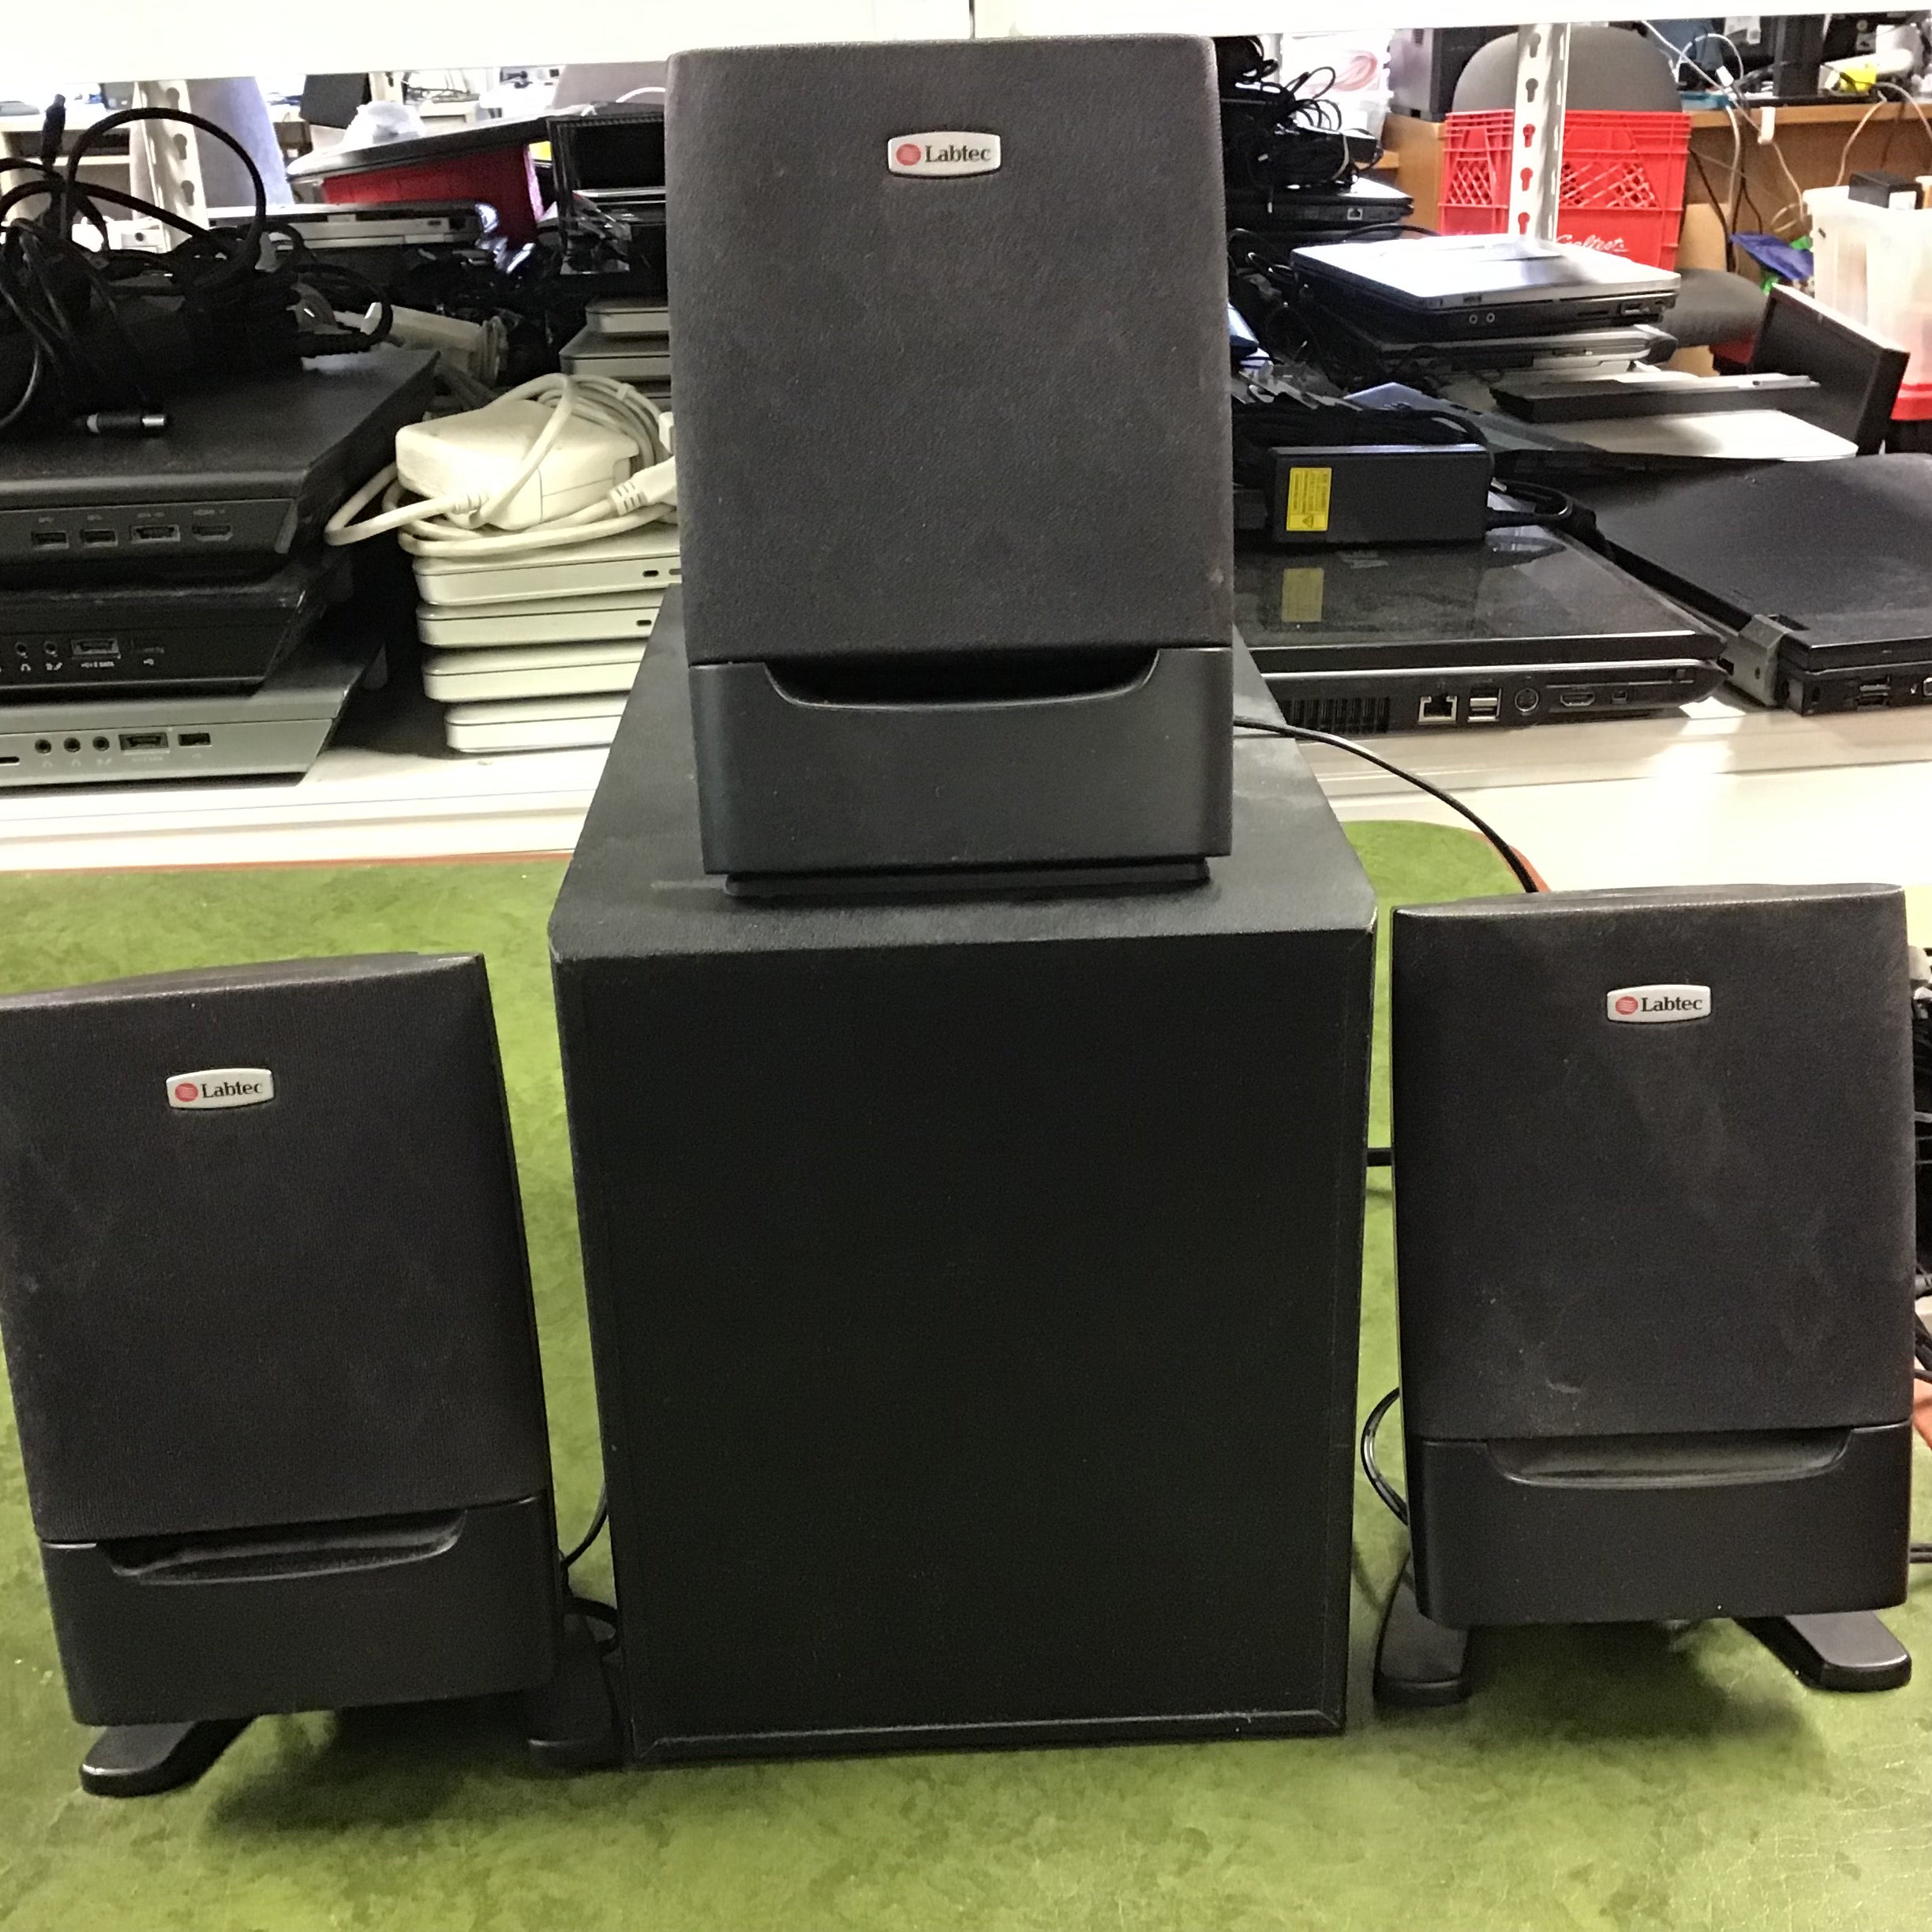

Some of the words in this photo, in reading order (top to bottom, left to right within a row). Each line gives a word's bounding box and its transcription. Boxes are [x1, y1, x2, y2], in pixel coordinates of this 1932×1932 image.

[925, 144, 991, 163] Labtec
[1641, 996, 1703, 1013] Labtec
[200, 1081, 264, 1099] Labtec
